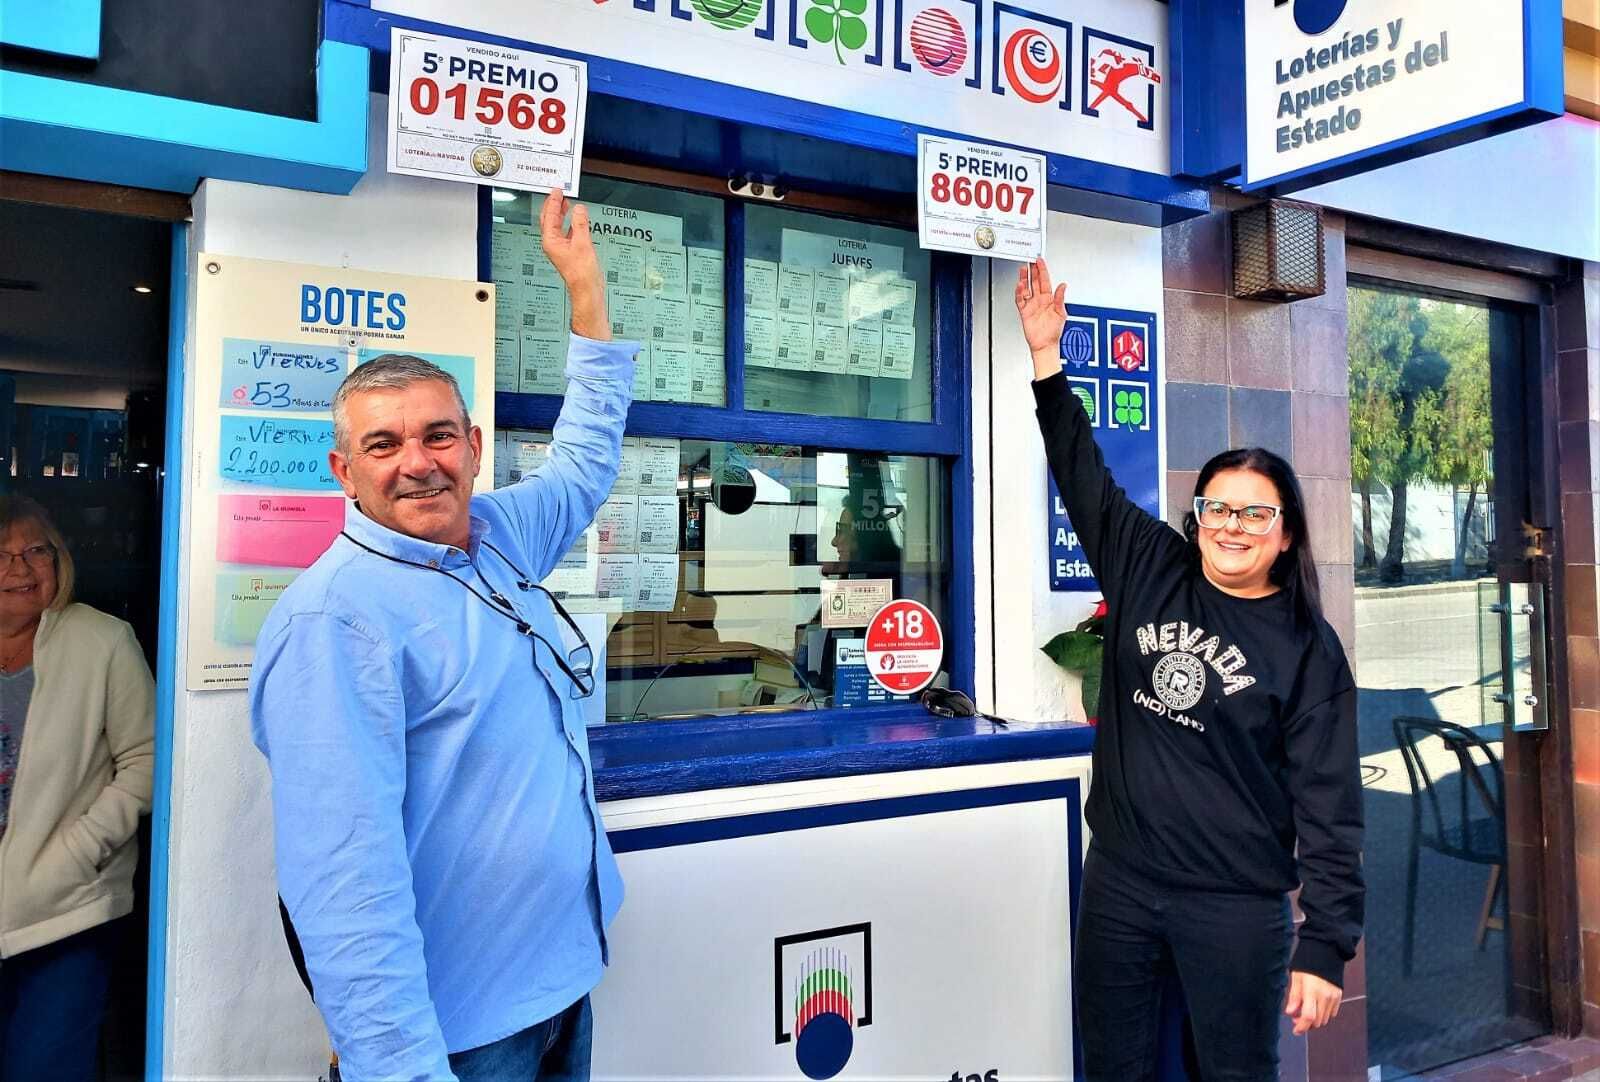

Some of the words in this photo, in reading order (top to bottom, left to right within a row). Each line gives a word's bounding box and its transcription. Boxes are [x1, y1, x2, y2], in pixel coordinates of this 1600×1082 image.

[1276, 27, 1379, 85] Loterías
[1387, 17, 1403, 51] y
[449, 56, 558, 93] PREMIO
[1277, 58, 1396, 120] Apuestas
[1404, 31, 1449, 74] del
[409, 77, 566, 134] 01568
[1276, 105, 1361, 153] Estado
[956, 155, 1028, 182] PREMIO
[931, 172, 1034, 215] 86007
[831, 252, 873, 270] JUEVES
[301, 284, 406, 331] BOTES
[250, 381, 291, 408] 53
[1056, 559, 1095, 577] Esta
[881, 610, 923, 639] +18
[1136, 620, 1256, 696] NEVADA
